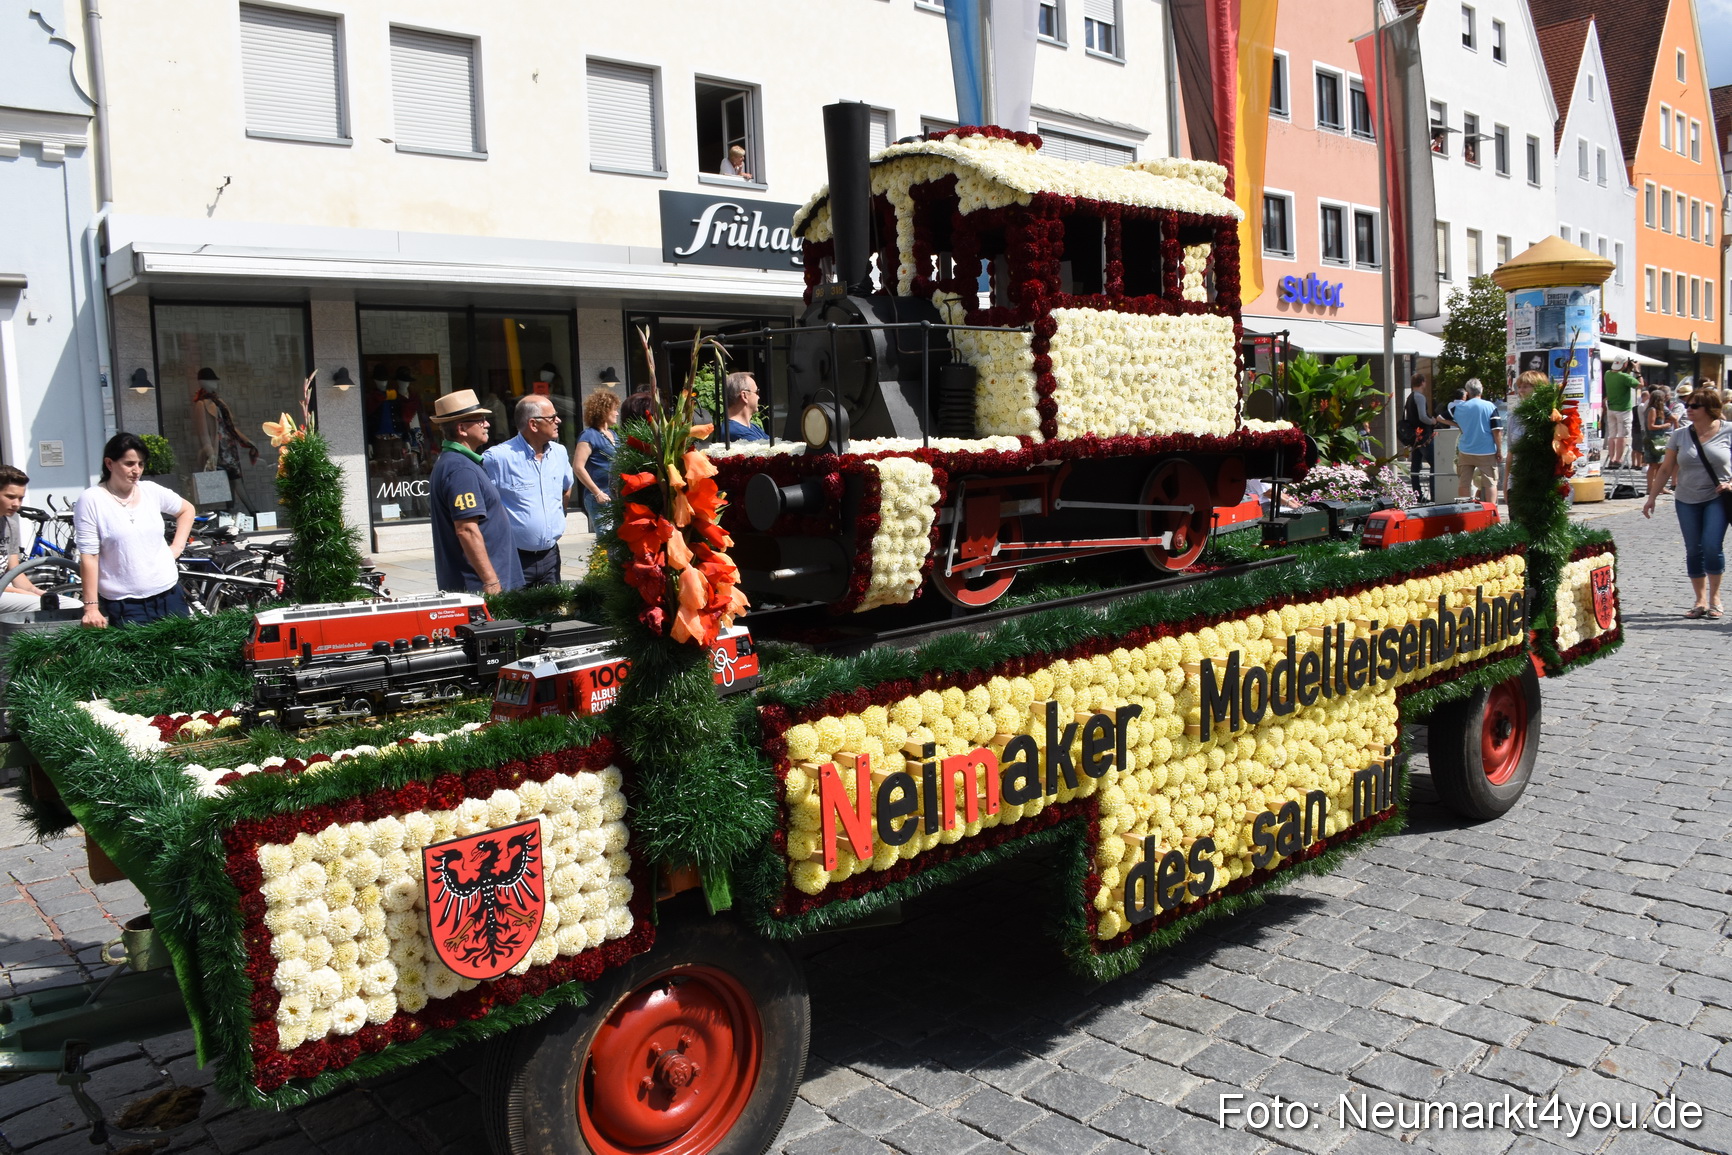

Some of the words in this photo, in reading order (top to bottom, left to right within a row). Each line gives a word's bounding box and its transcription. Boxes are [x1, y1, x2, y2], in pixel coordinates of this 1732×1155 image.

[454, 492, 477, 511] 48
[590, 663, 629, 689] 100
[818, 700, 1143, 871] Neimaker
[1200, 585, 1537, 743] Modelleisenbahner
[1124, 834, 1215, 924] des
[1252, 790, 1326, 869] san
[1353, 744, 1408, 823] mir
